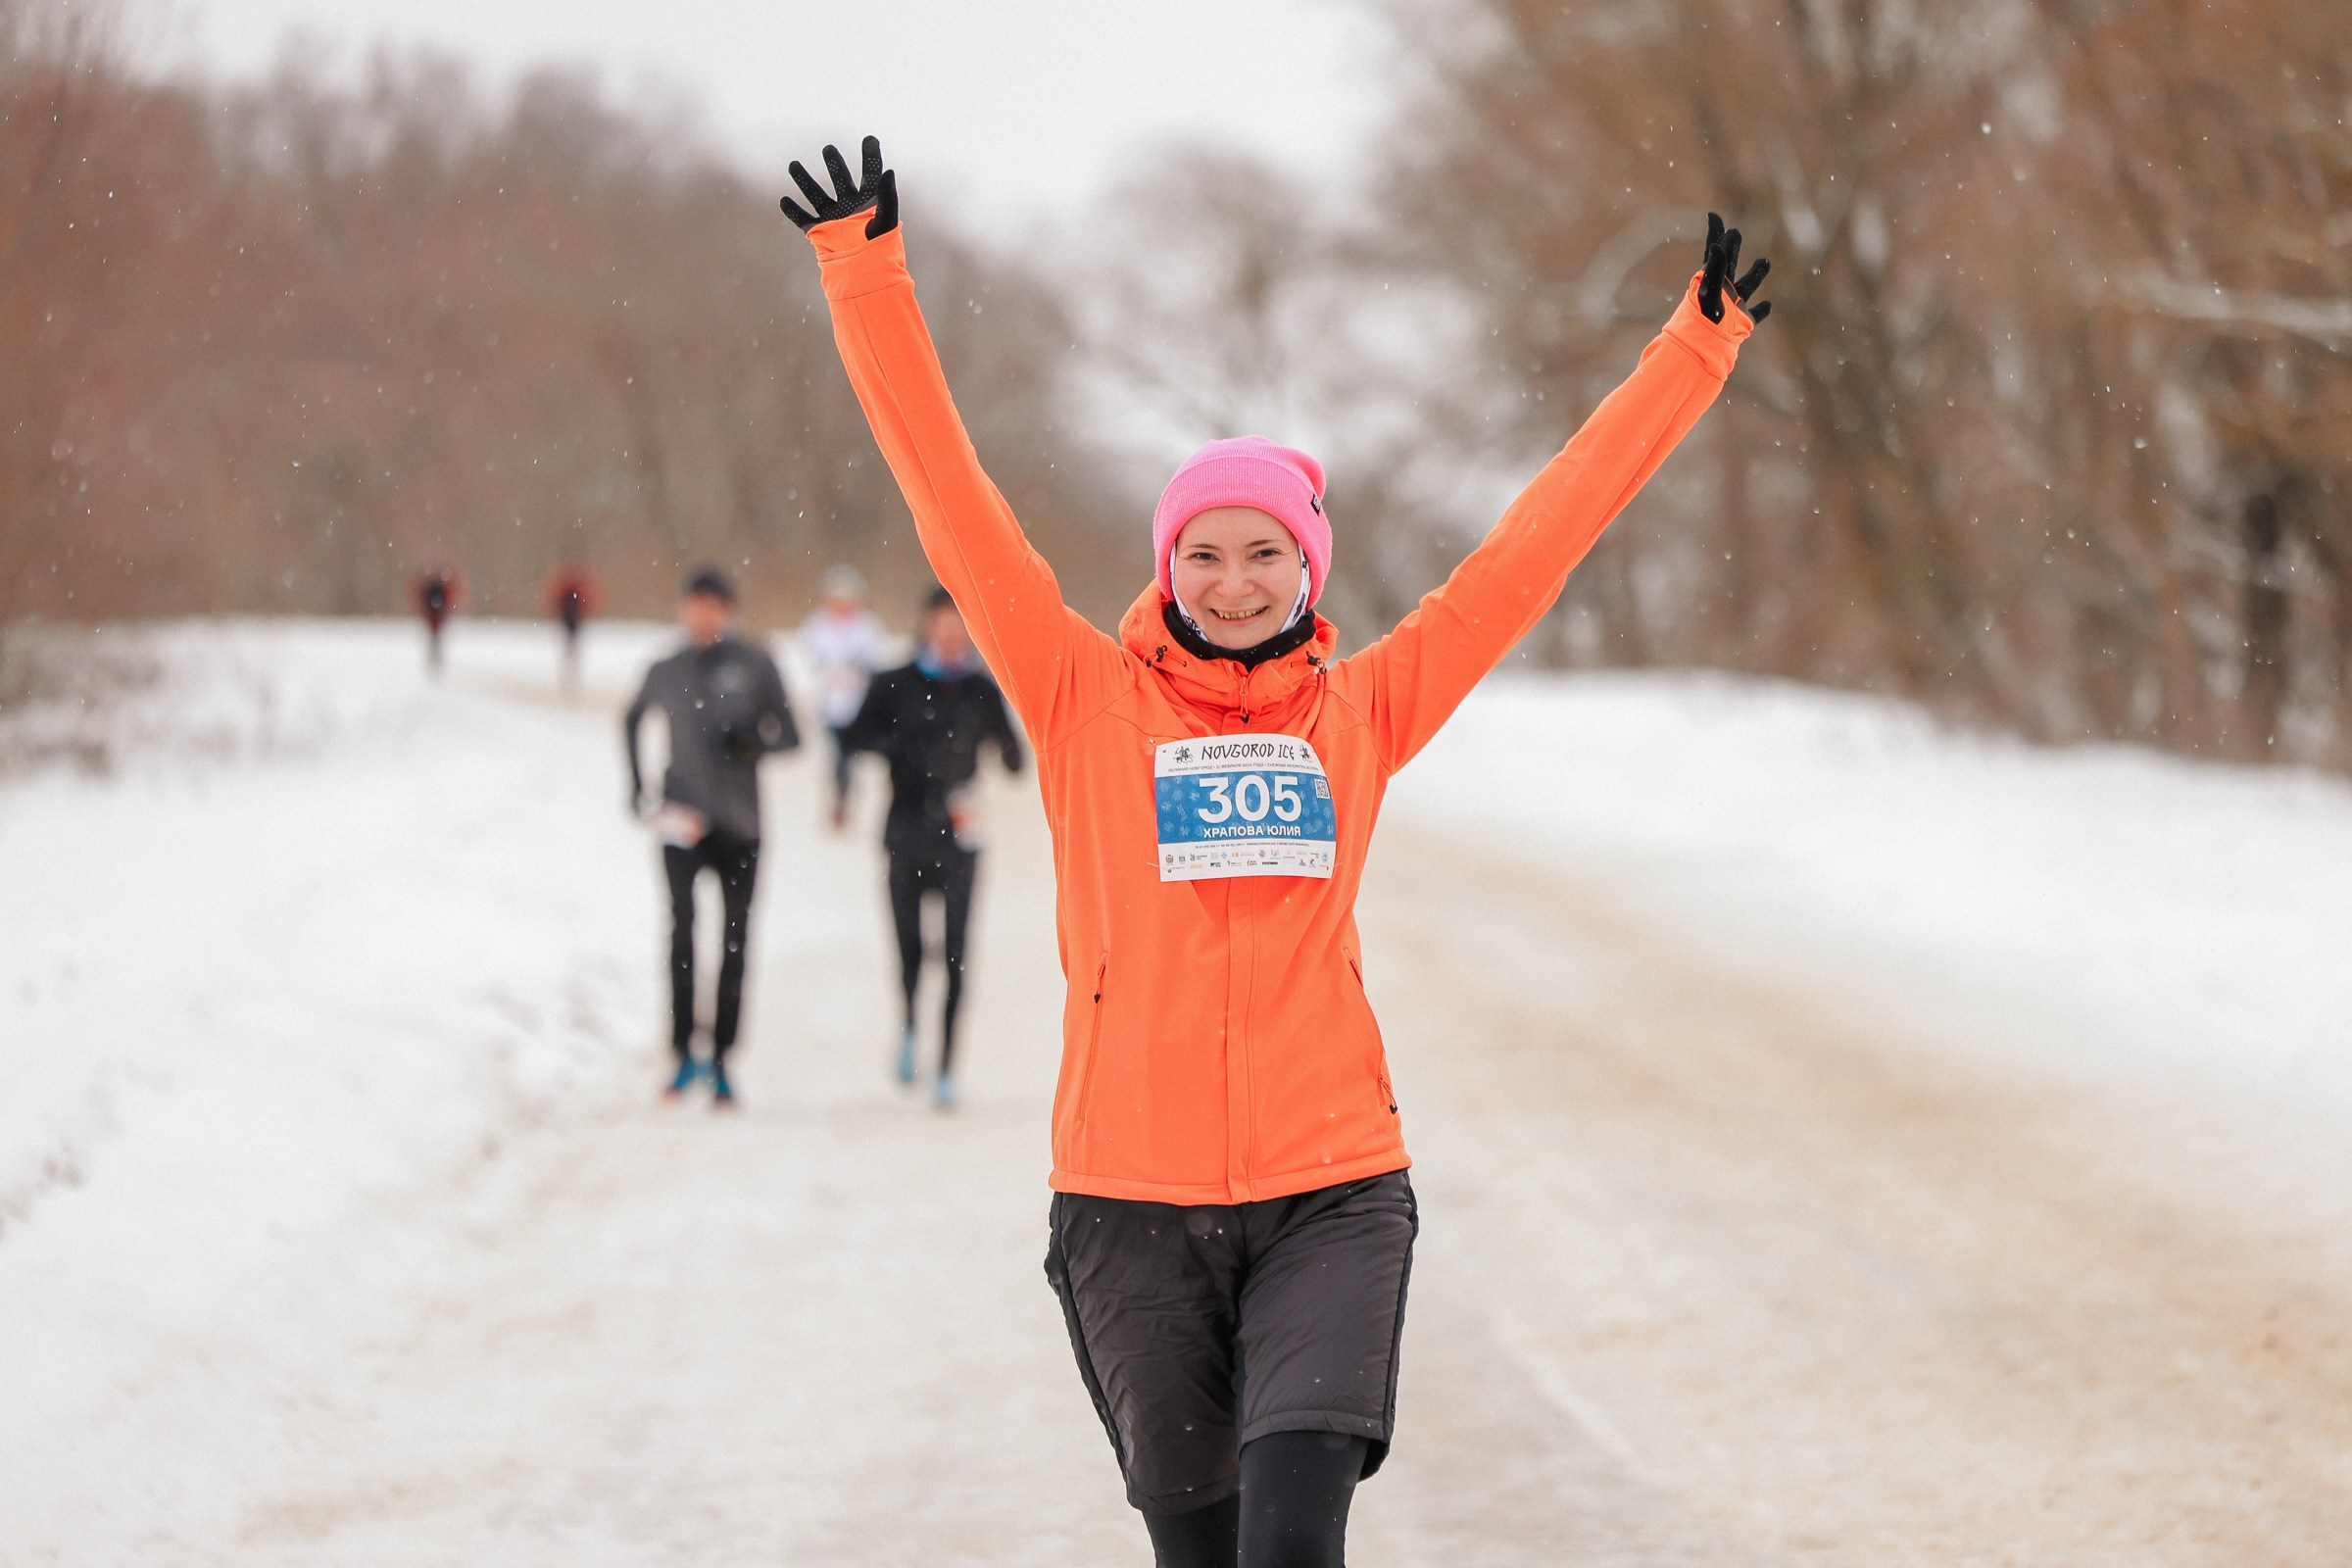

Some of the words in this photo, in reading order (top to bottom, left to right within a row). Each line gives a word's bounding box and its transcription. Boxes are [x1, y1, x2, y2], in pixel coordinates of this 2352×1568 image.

[1201, 744, 1274, 760] NOVGOROD
[1278, 744, 1295, 760] ICE
[1198, 774, 1302, 824] 305
[1203, 826, 1264, 839] ХРАПОВА
[1267, 825, 1301, 836] ЮЛИЯ
